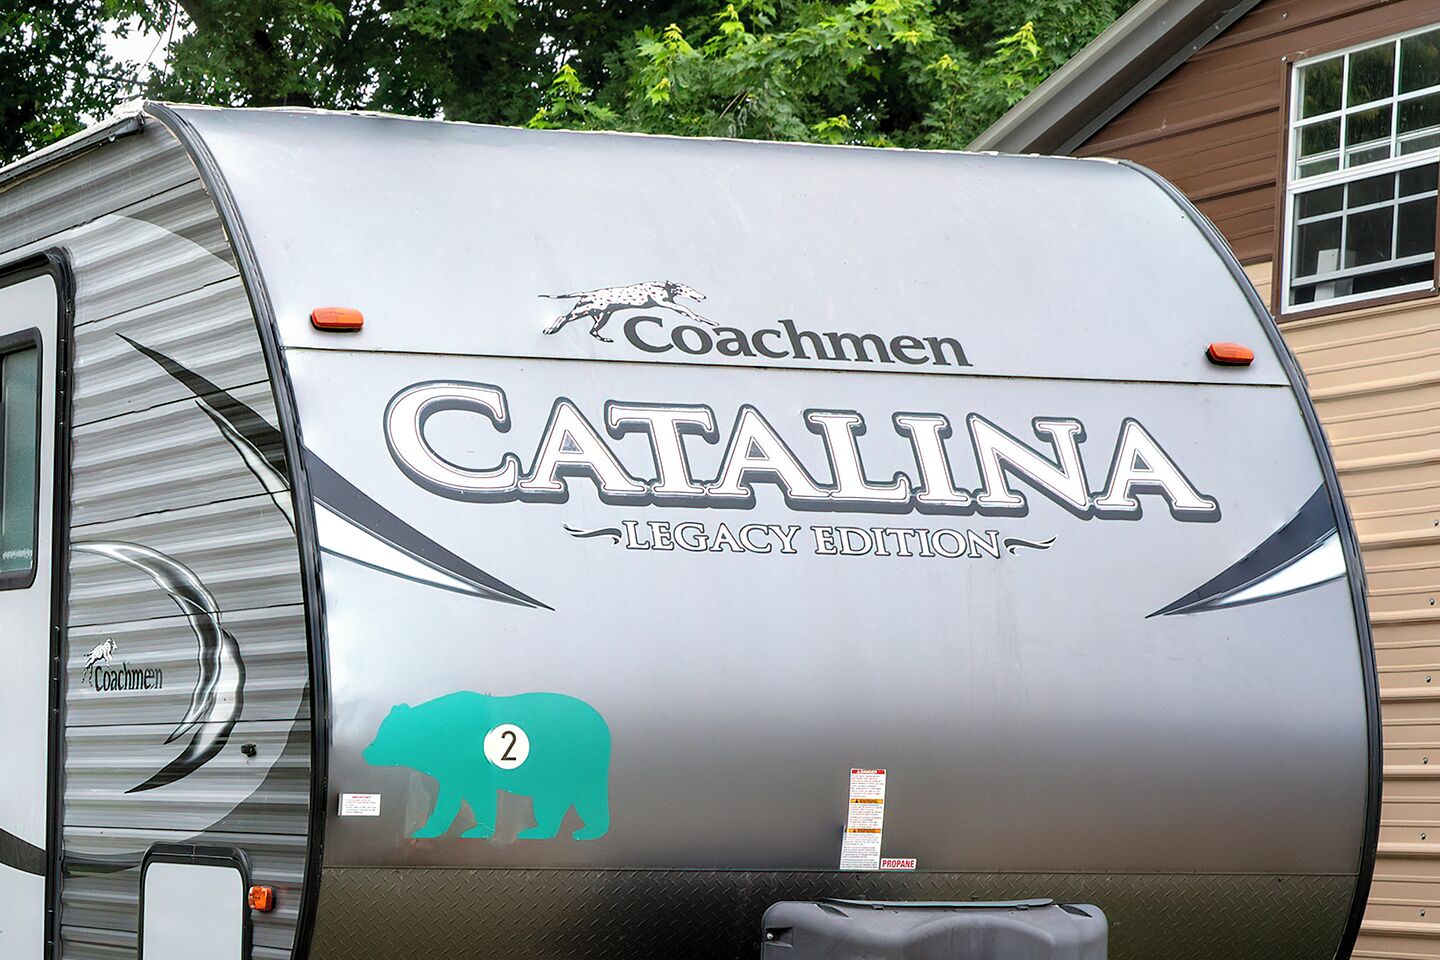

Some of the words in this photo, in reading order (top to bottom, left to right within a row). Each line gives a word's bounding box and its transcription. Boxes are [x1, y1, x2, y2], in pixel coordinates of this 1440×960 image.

[623, 315, 973, 366] Coachmen
[382, 379, 1222, 524] CATALINA
[621, 519, 801, 555] LEGACY
[811, 524, 1003, 561] EDITION
[94, 661, 163, 692] Coachmen
[500, 730, 517, 761] 2
[881, 859, 915, 869] PROPANE
